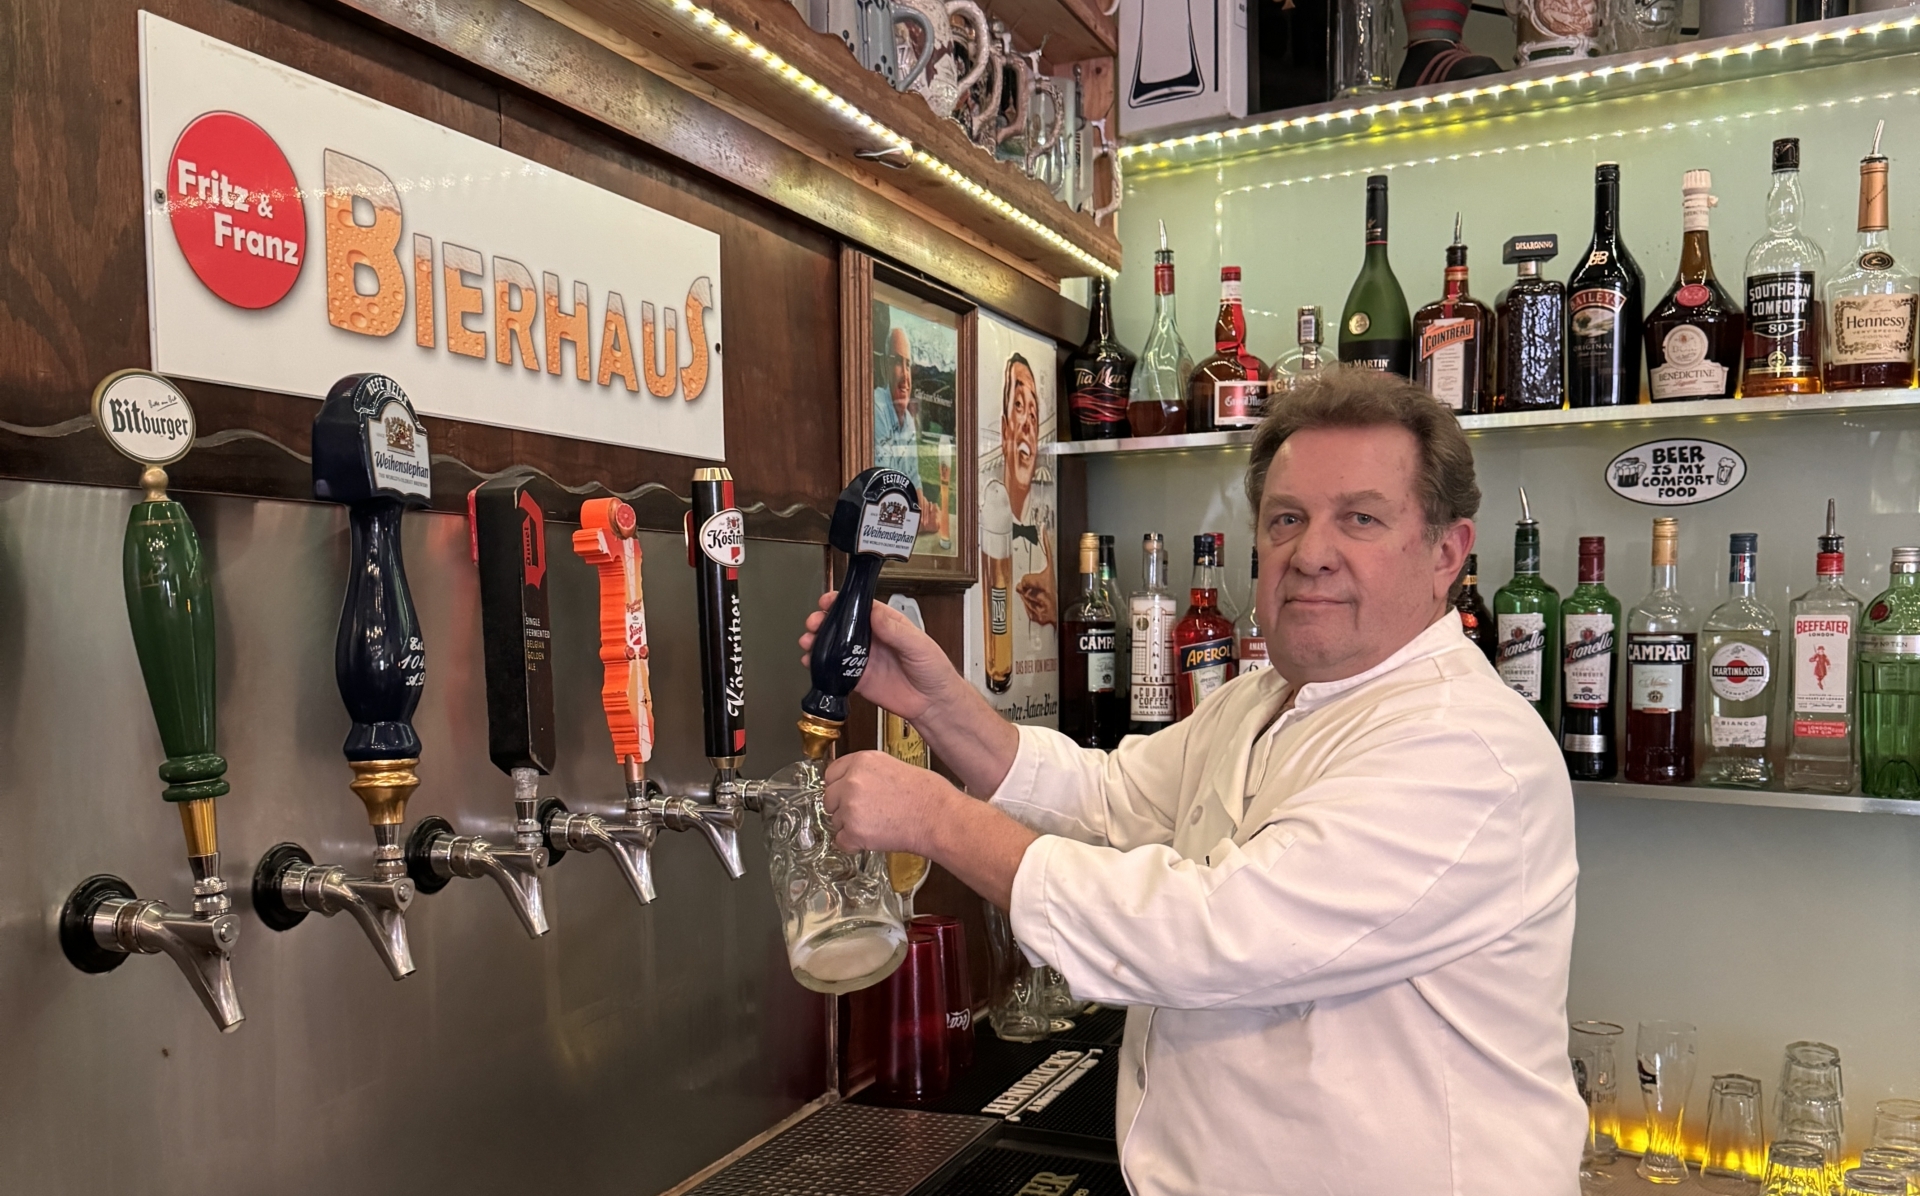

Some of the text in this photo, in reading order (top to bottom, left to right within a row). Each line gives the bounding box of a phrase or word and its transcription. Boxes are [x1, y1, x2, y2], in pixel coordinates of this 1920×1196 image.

[177, 159, 273, 219] Fritz &
[214, 212, 299, 266] Franz
[1515, 241, 1554, 251] DISARONNO
[324, 147, 713, 402] BIERHAUS
[1749, 282, 1811, 302] SOUTHERN
[1570, 291, 1618, 311] BAILEYS
[1752, 299, 1807, 316] COMFORT
[1768, 323, 1788, 334] 80
[1846, 316, 1908, 329] Hennessy
[1425, 323, 1472, 353] COINTREAU
[1353, 359, 1389, 369] MARTIN
[109, 398, 188, 441] Bitburger
[1652, 446, 1706, 464] BEER
[374, 450, 429, 479] Weihenstephan
[1652, 464, 1705, 476] IS MY
[882, 474, 910, 489] FESTBIER
[1642, 475, 1715, 487] COMFORT
[1658, 486, 1697, 498] FOOD
[863, 524, 914, 543] Weihenstephan
[526, 628, 550, 639] FERMENTED
[1797, 620, 1848, 635] BEEFEATER
[527, 639, 545, 649] BELGIAN
[1079, 636, 1115, 650] CAMP
[528, 651, 545, 661] GOLDEN
[1186, 644, 1231, 668] APEROL
[1628, 643, 1691, 661] CAMPARI
[528, 662, 536, 671] ALE
[1138, 687, 1169, 698] CUBAN
[1572, 693, 1602, 701] STOCK
[1138, 697, 1169, 706] COFFEE
